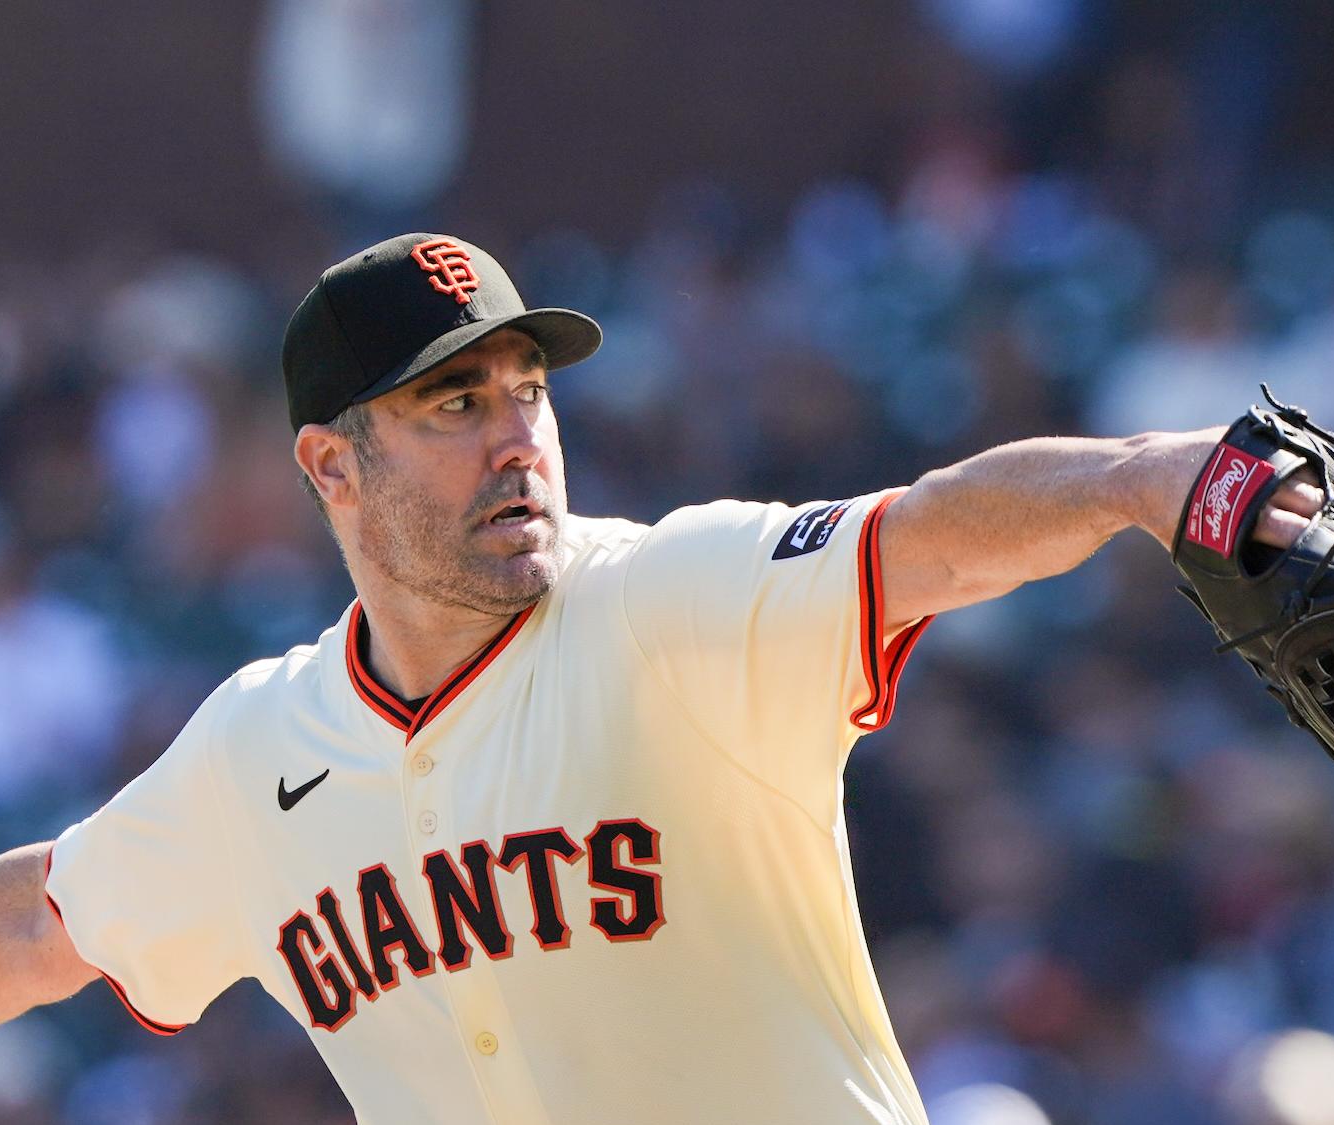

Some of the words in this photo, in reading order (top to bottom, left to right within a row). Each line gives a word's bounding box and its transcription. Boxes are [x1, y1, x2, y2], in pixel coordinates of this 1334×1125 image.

[410, 238, 480, 304] SF
[1205, 458, 1247, 541] Rawlings
[277, 817, 667, 1033] GIANTS
